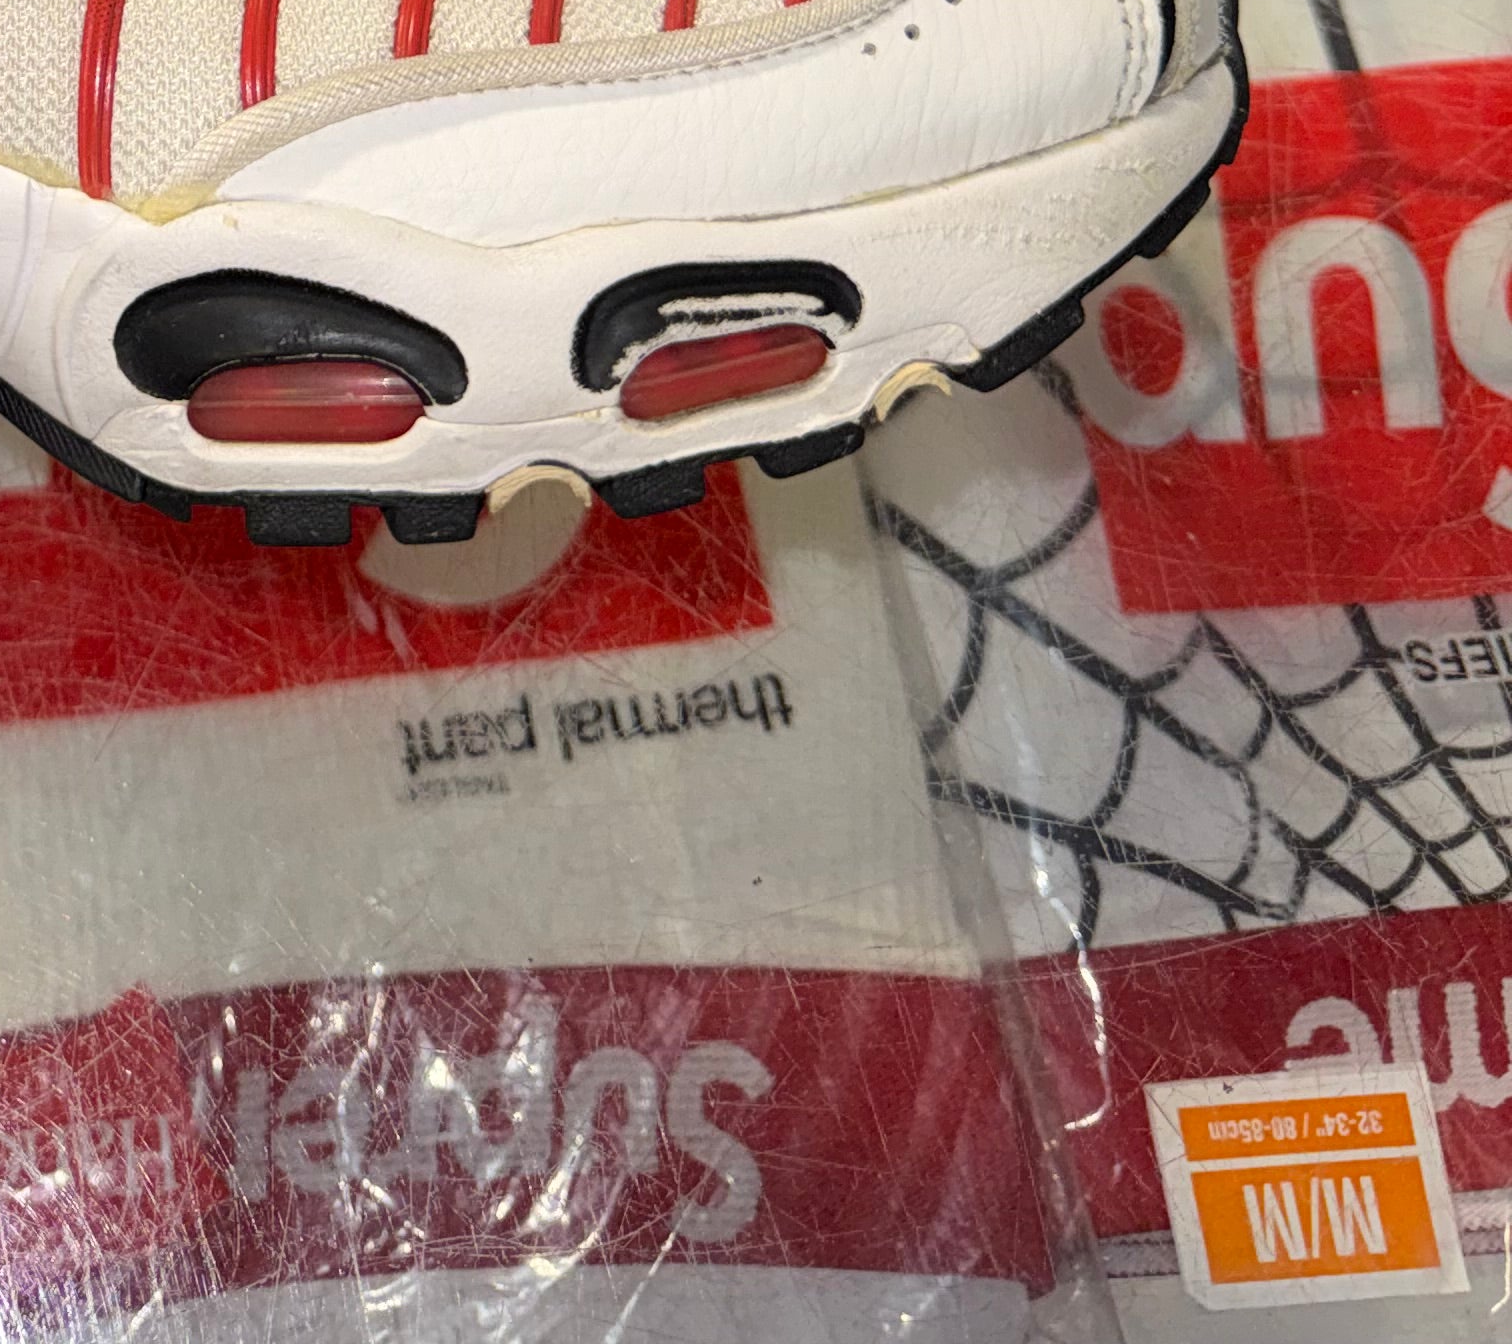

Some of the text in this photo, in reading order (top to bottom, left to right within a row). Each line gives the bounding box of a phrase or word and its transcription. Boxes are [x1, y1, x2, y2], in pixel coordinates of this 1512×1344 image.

[1405, 634, 1512, 682] IEFS
[397, 673, 793, 774] thermal pant
[191, 999, 774, 1243] Supre
[1207, 1110, 1384, 1144] 32-34" / 80-85cm
[1242, 1175, 1388, 1264] M/M
